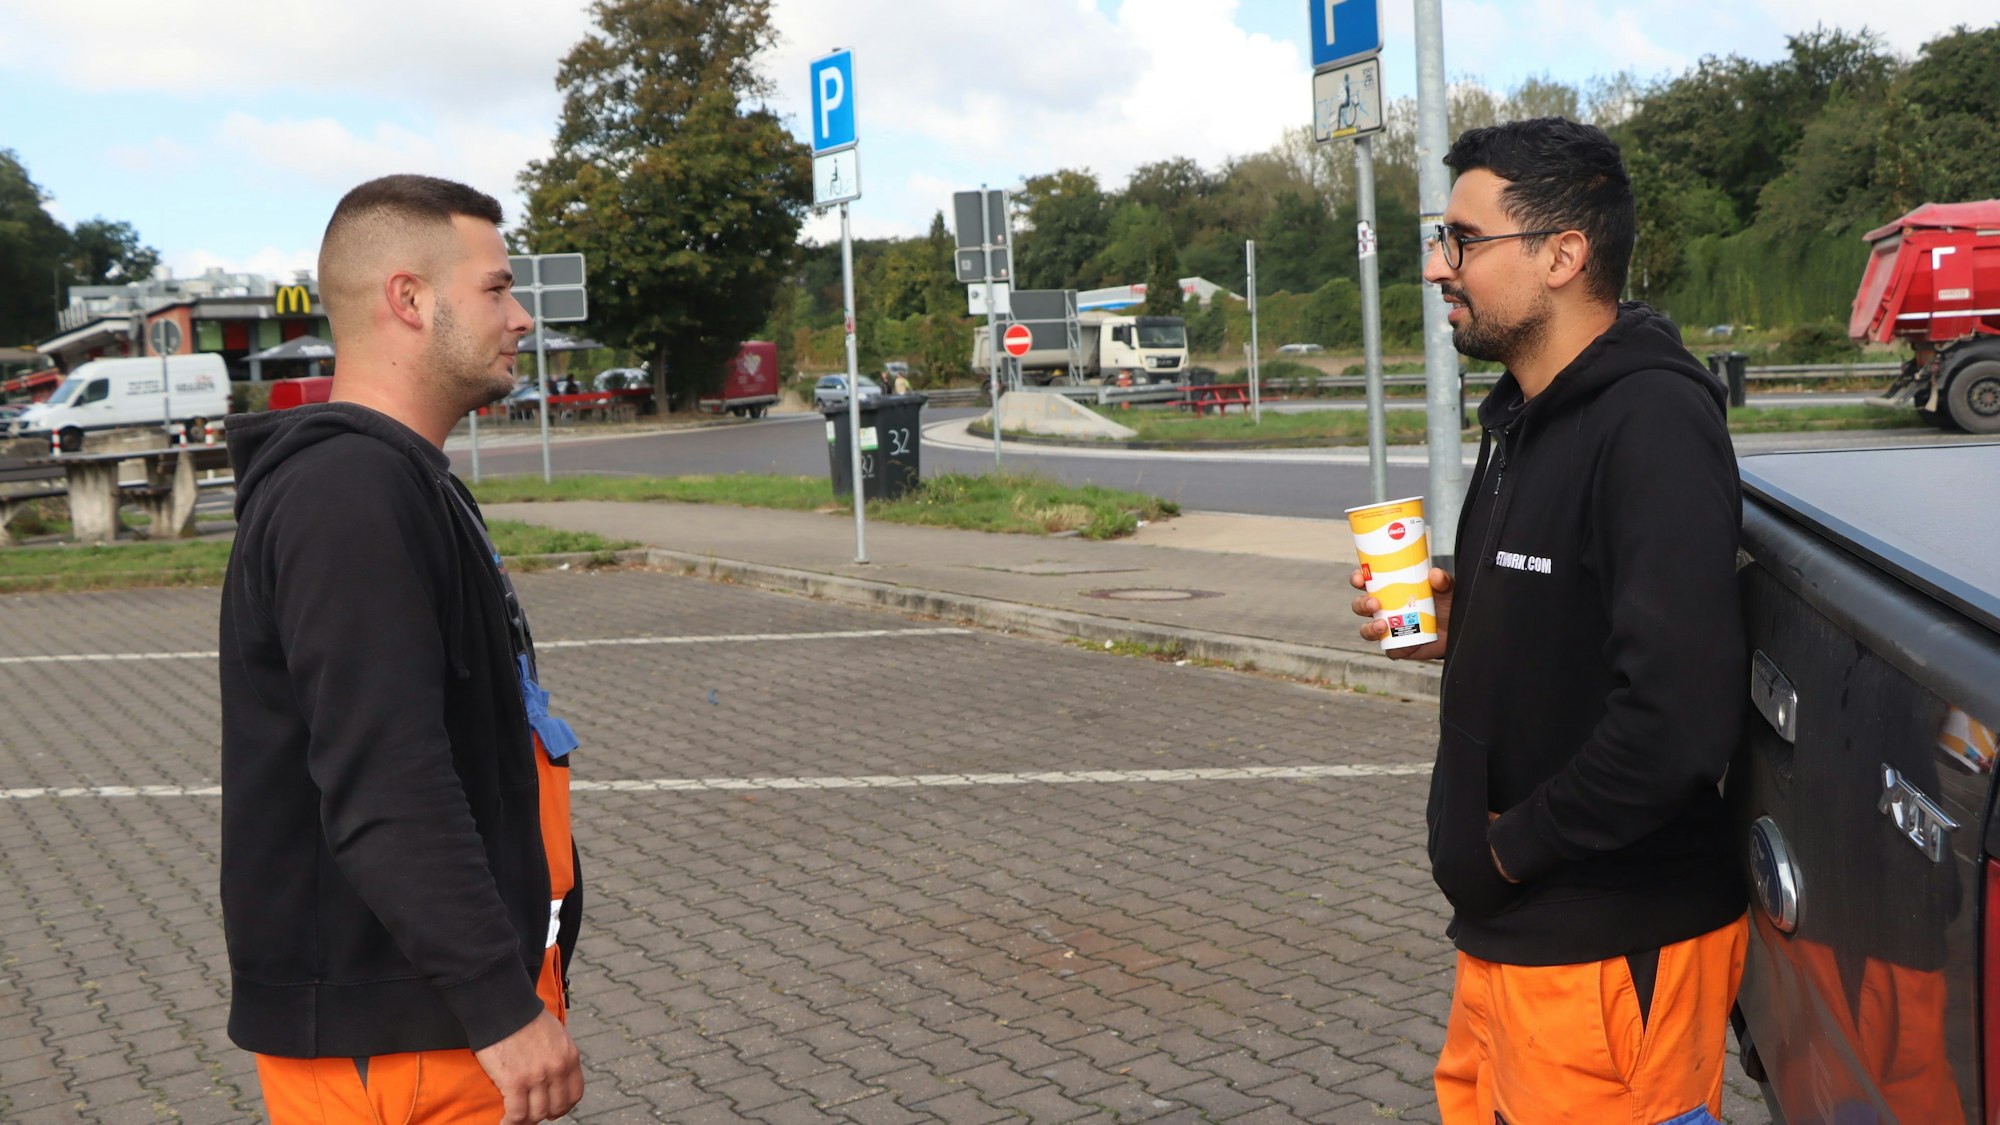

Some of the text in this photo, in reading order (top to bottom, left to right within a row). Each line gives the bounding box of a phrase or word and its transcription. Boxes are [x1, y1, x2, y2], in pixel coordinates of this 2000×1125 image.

[819, 66, 844, 139] P
[276, 285, 311, 315] M
[888, 428, 910, 456] 32
